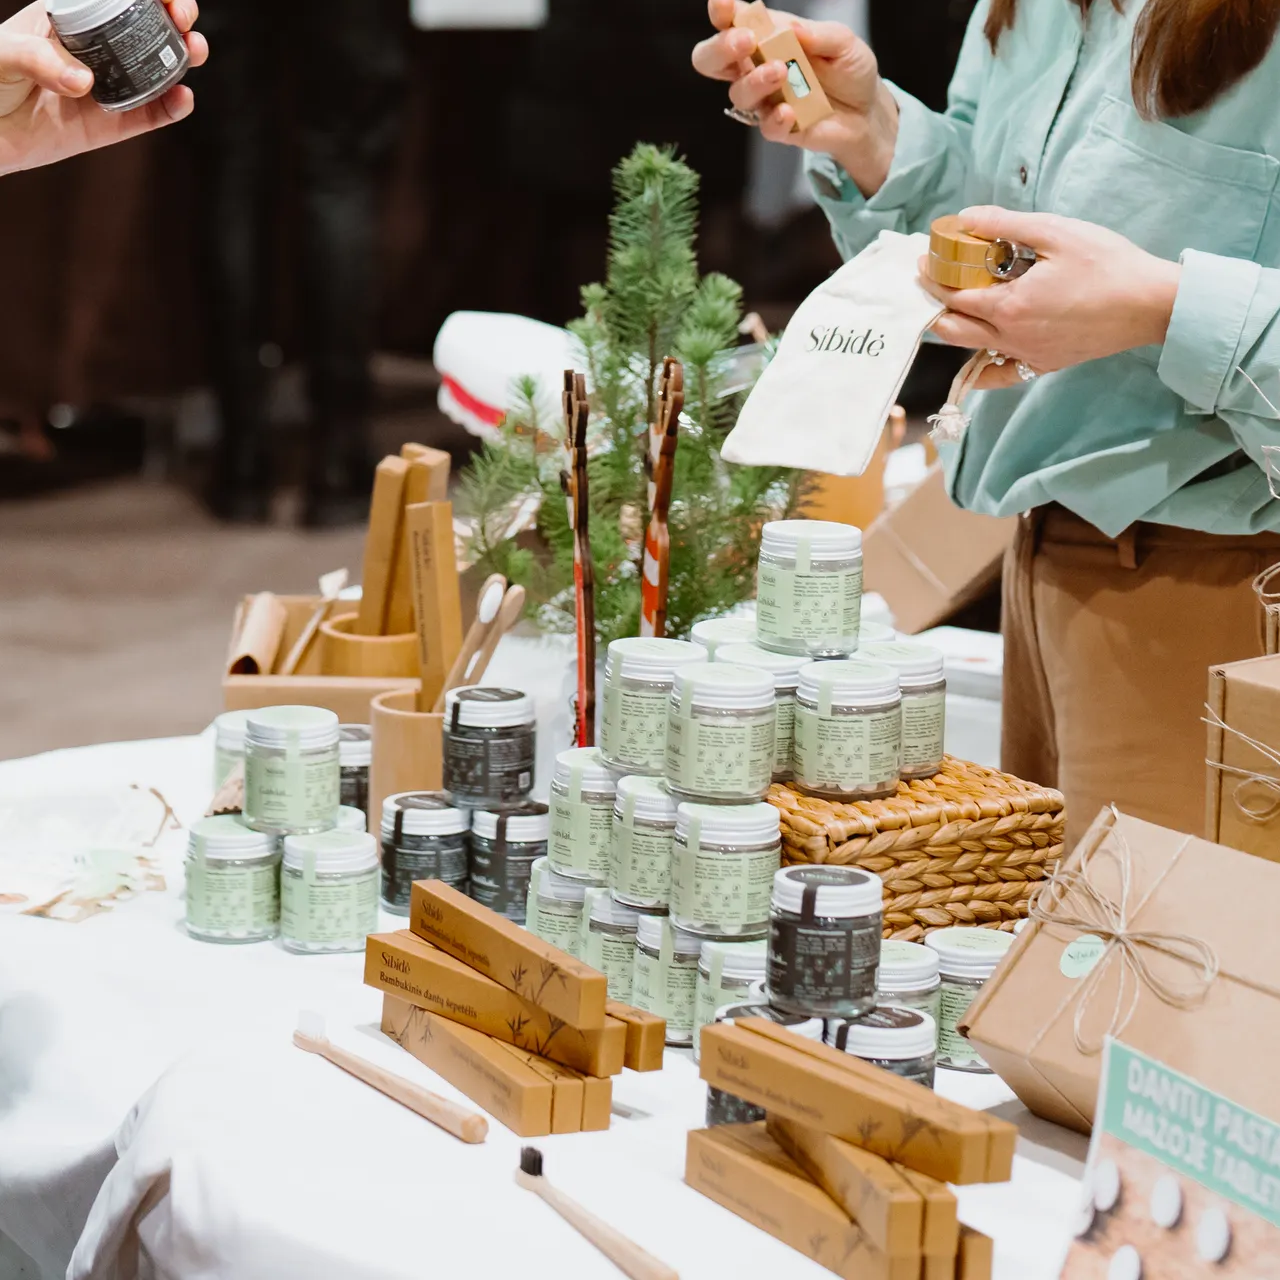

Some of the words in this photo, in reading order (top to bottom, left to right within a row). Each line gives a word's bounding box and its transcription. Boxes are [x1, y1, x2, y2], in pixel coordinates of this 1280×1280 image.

[806, 324, 886, 357] Sibidė
[381, 951, 411, 975] Sibidė
[380, 971, 422, 996] Bambukinis
[423, 989, 445, 1008] dantų
[445, 998, 478, 1019] šepetėlis
